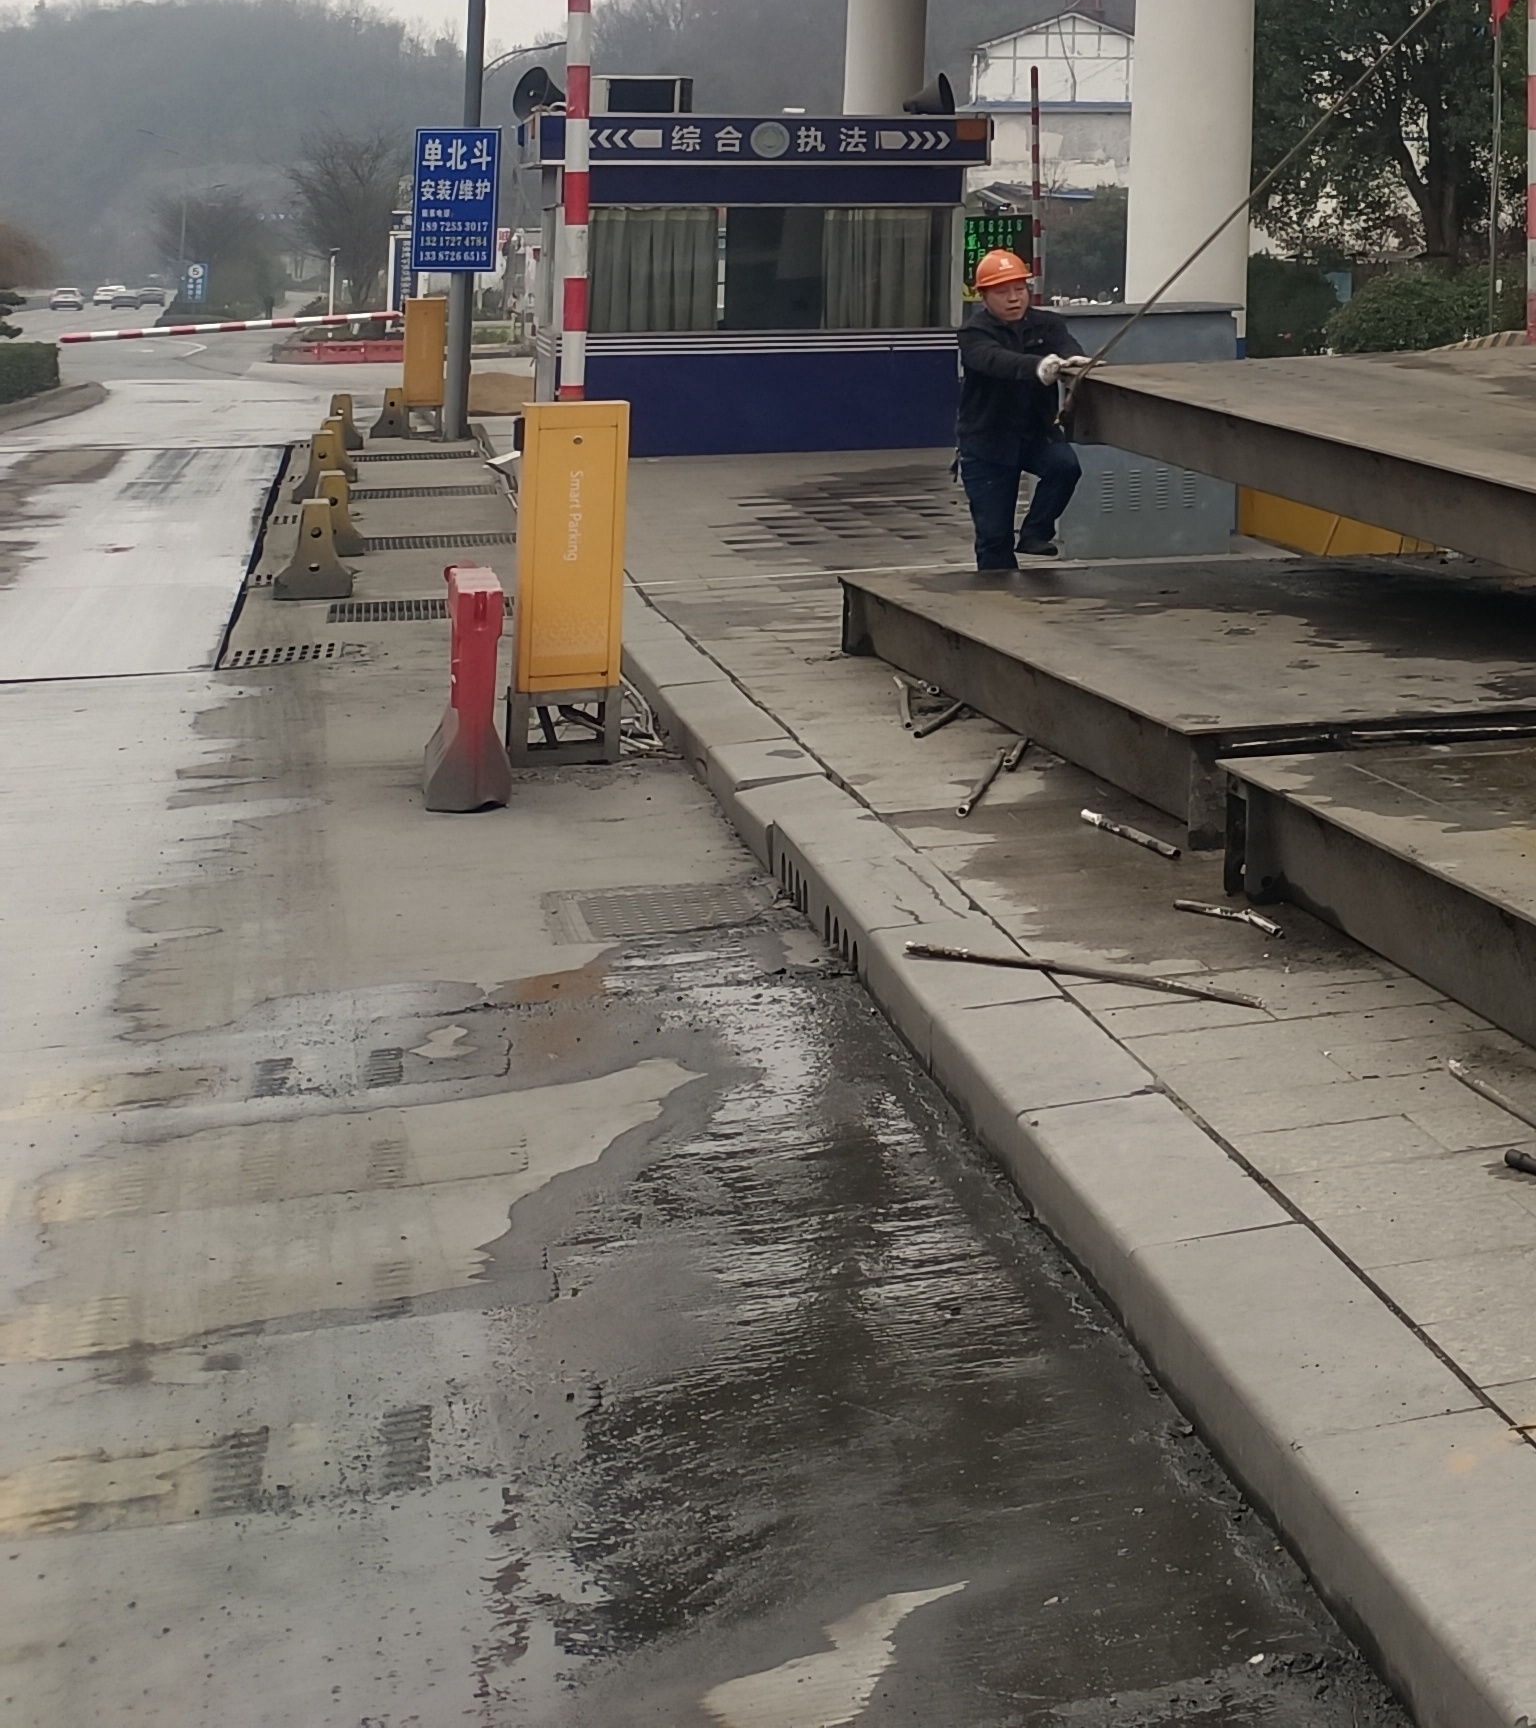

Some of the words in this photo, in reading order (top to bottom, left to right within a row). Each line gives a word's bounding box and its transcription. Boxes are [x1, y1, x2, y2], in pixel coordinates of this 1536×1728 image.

[421, 138, 492, 171] 单北斗
[671, 125, 744, 153] 综合
[796, 125, 869, 154] 执法
[420, 178, 491, 202] 安装/维护
[569, 470, 583, 509] Smart
[562, 512, 582, 561] Parking
